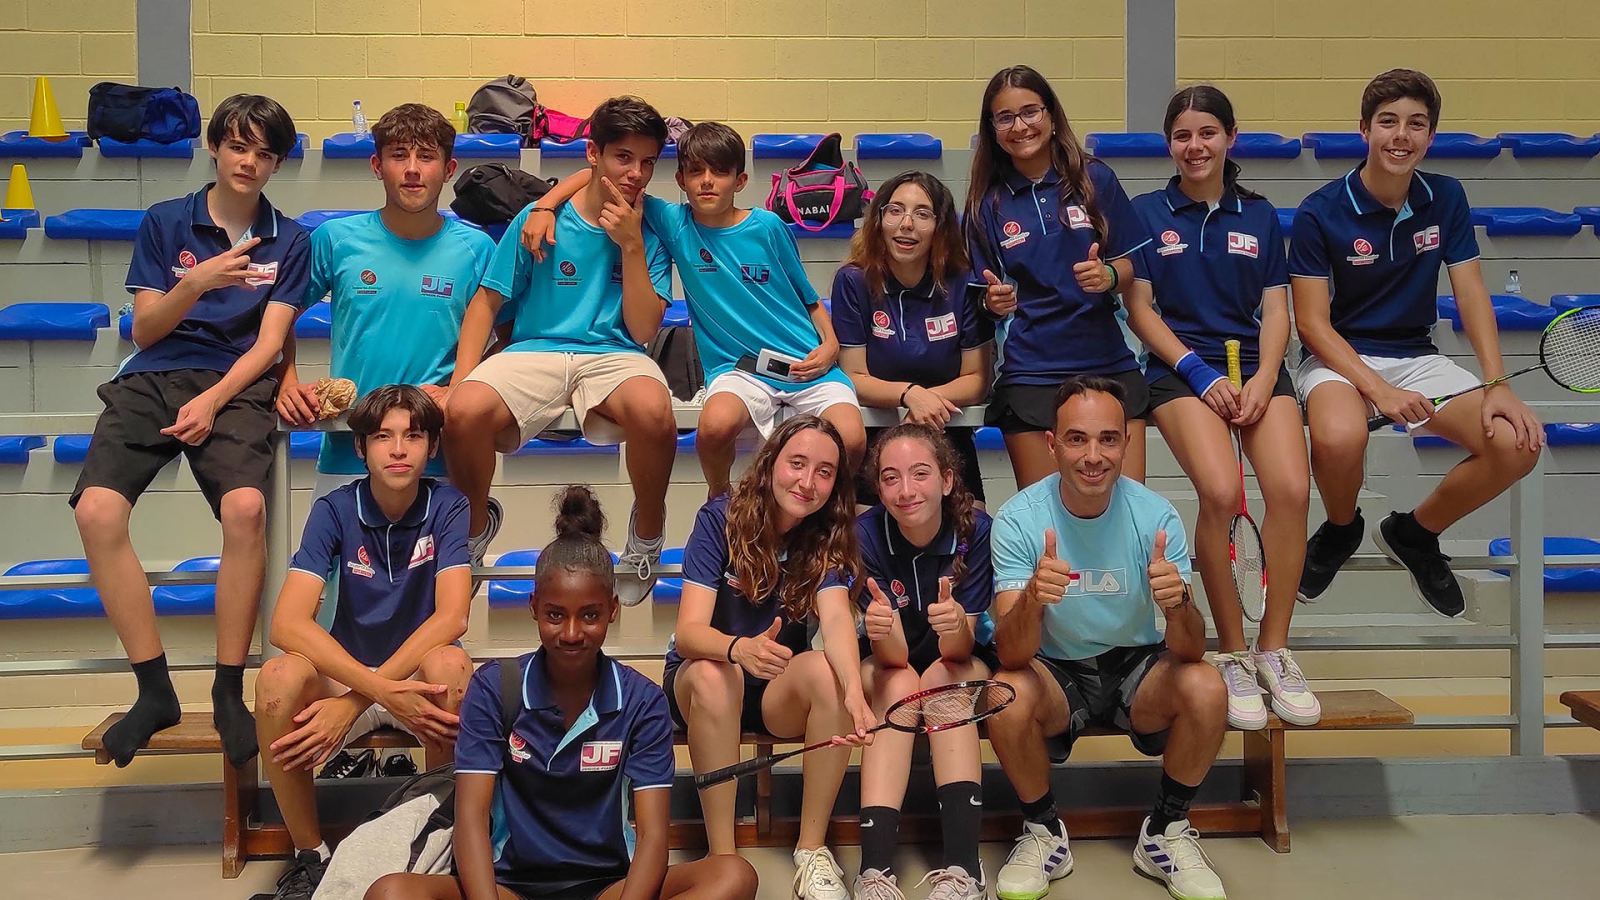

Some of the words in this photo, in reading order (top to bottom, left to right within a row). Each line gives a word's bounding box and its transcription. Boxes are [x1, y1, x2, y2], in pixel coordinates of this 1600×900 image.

[1230, 234, 1257, 251] JF
[422, 277, 453, 293] JF
[928, 315, 955, 334] JF
[1065, 571, 1120, 593] FILA
[582, 745, 620, 763] JF
